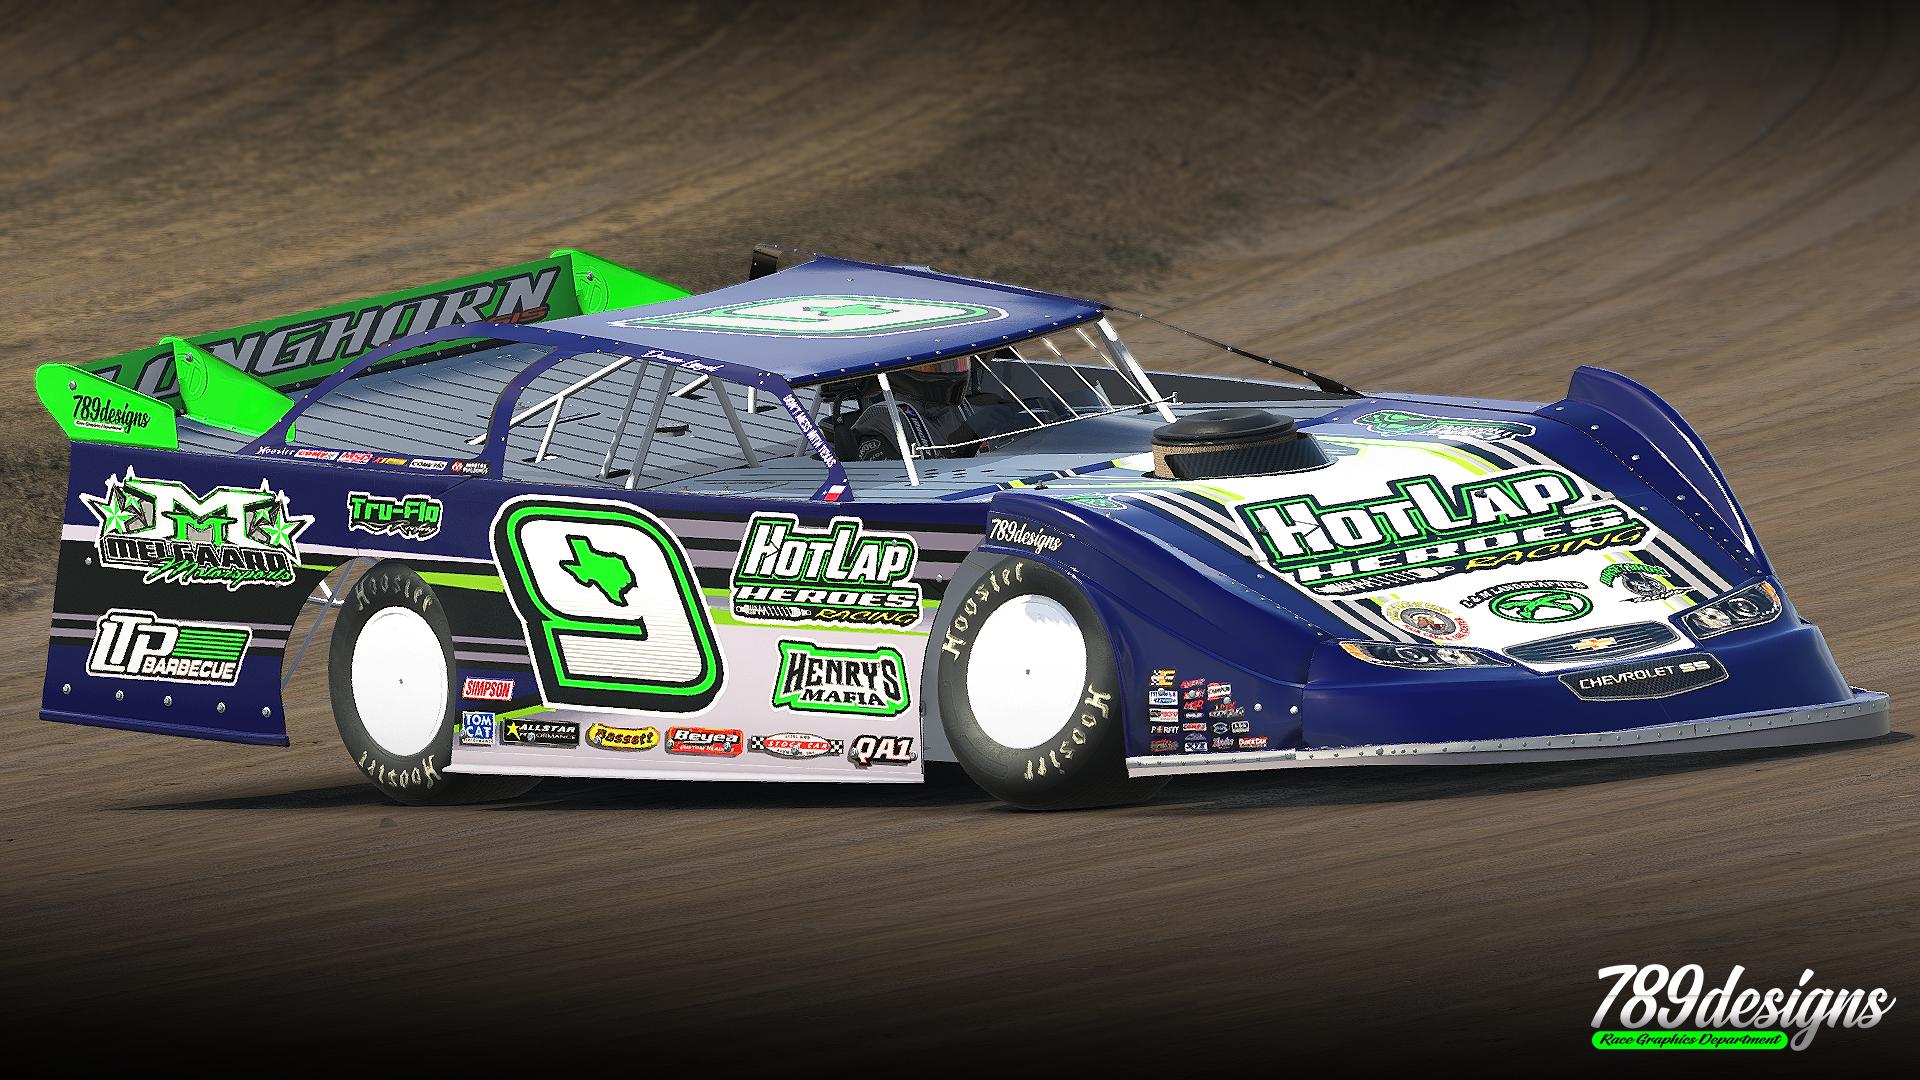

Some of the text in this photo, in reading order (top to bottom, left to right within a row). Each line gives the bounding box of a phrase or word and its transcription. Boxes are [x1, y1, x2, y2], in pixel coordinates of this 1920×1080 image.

[72, 395, 151, 434] 789designs
[351, 497, 439, 523] Tru-Flo
[990, 518, 1063, 555] 789designs
[1295, 511, 1625, 581] HEROES
[1466, 526, 1645, 570] RACING
[146, 556, 291, 588] Motorsports
[355, 573, 433, 612] Hoosier
[498, 499, 722, 709] 9
[736, 587, 917, 608] HEROES
[816, 608, 918, 625] RACING
[942, 561, 1024, 662] Hoosier
[142, 656, 237, 680] BARBECUE
[1579, 660, 1711, 690] CHEVROLET SS
[465, 680, 511, 699] SIMPSON
[800, 689, 886, 707] MAFIA
[465, 713, 492, 726] TOM
[465, 726, 491, 738] CAT
[519, 723, 576, 733] ALLSTAR
[1024, 683, 1112, 781] Hoosier
[674, 730, 739, 744] Beyea
[768, 740, 828, 750] STOCK CAR
[855, 737, 914, 763] QA1
[358, 750, 442, 789] Hoosier
